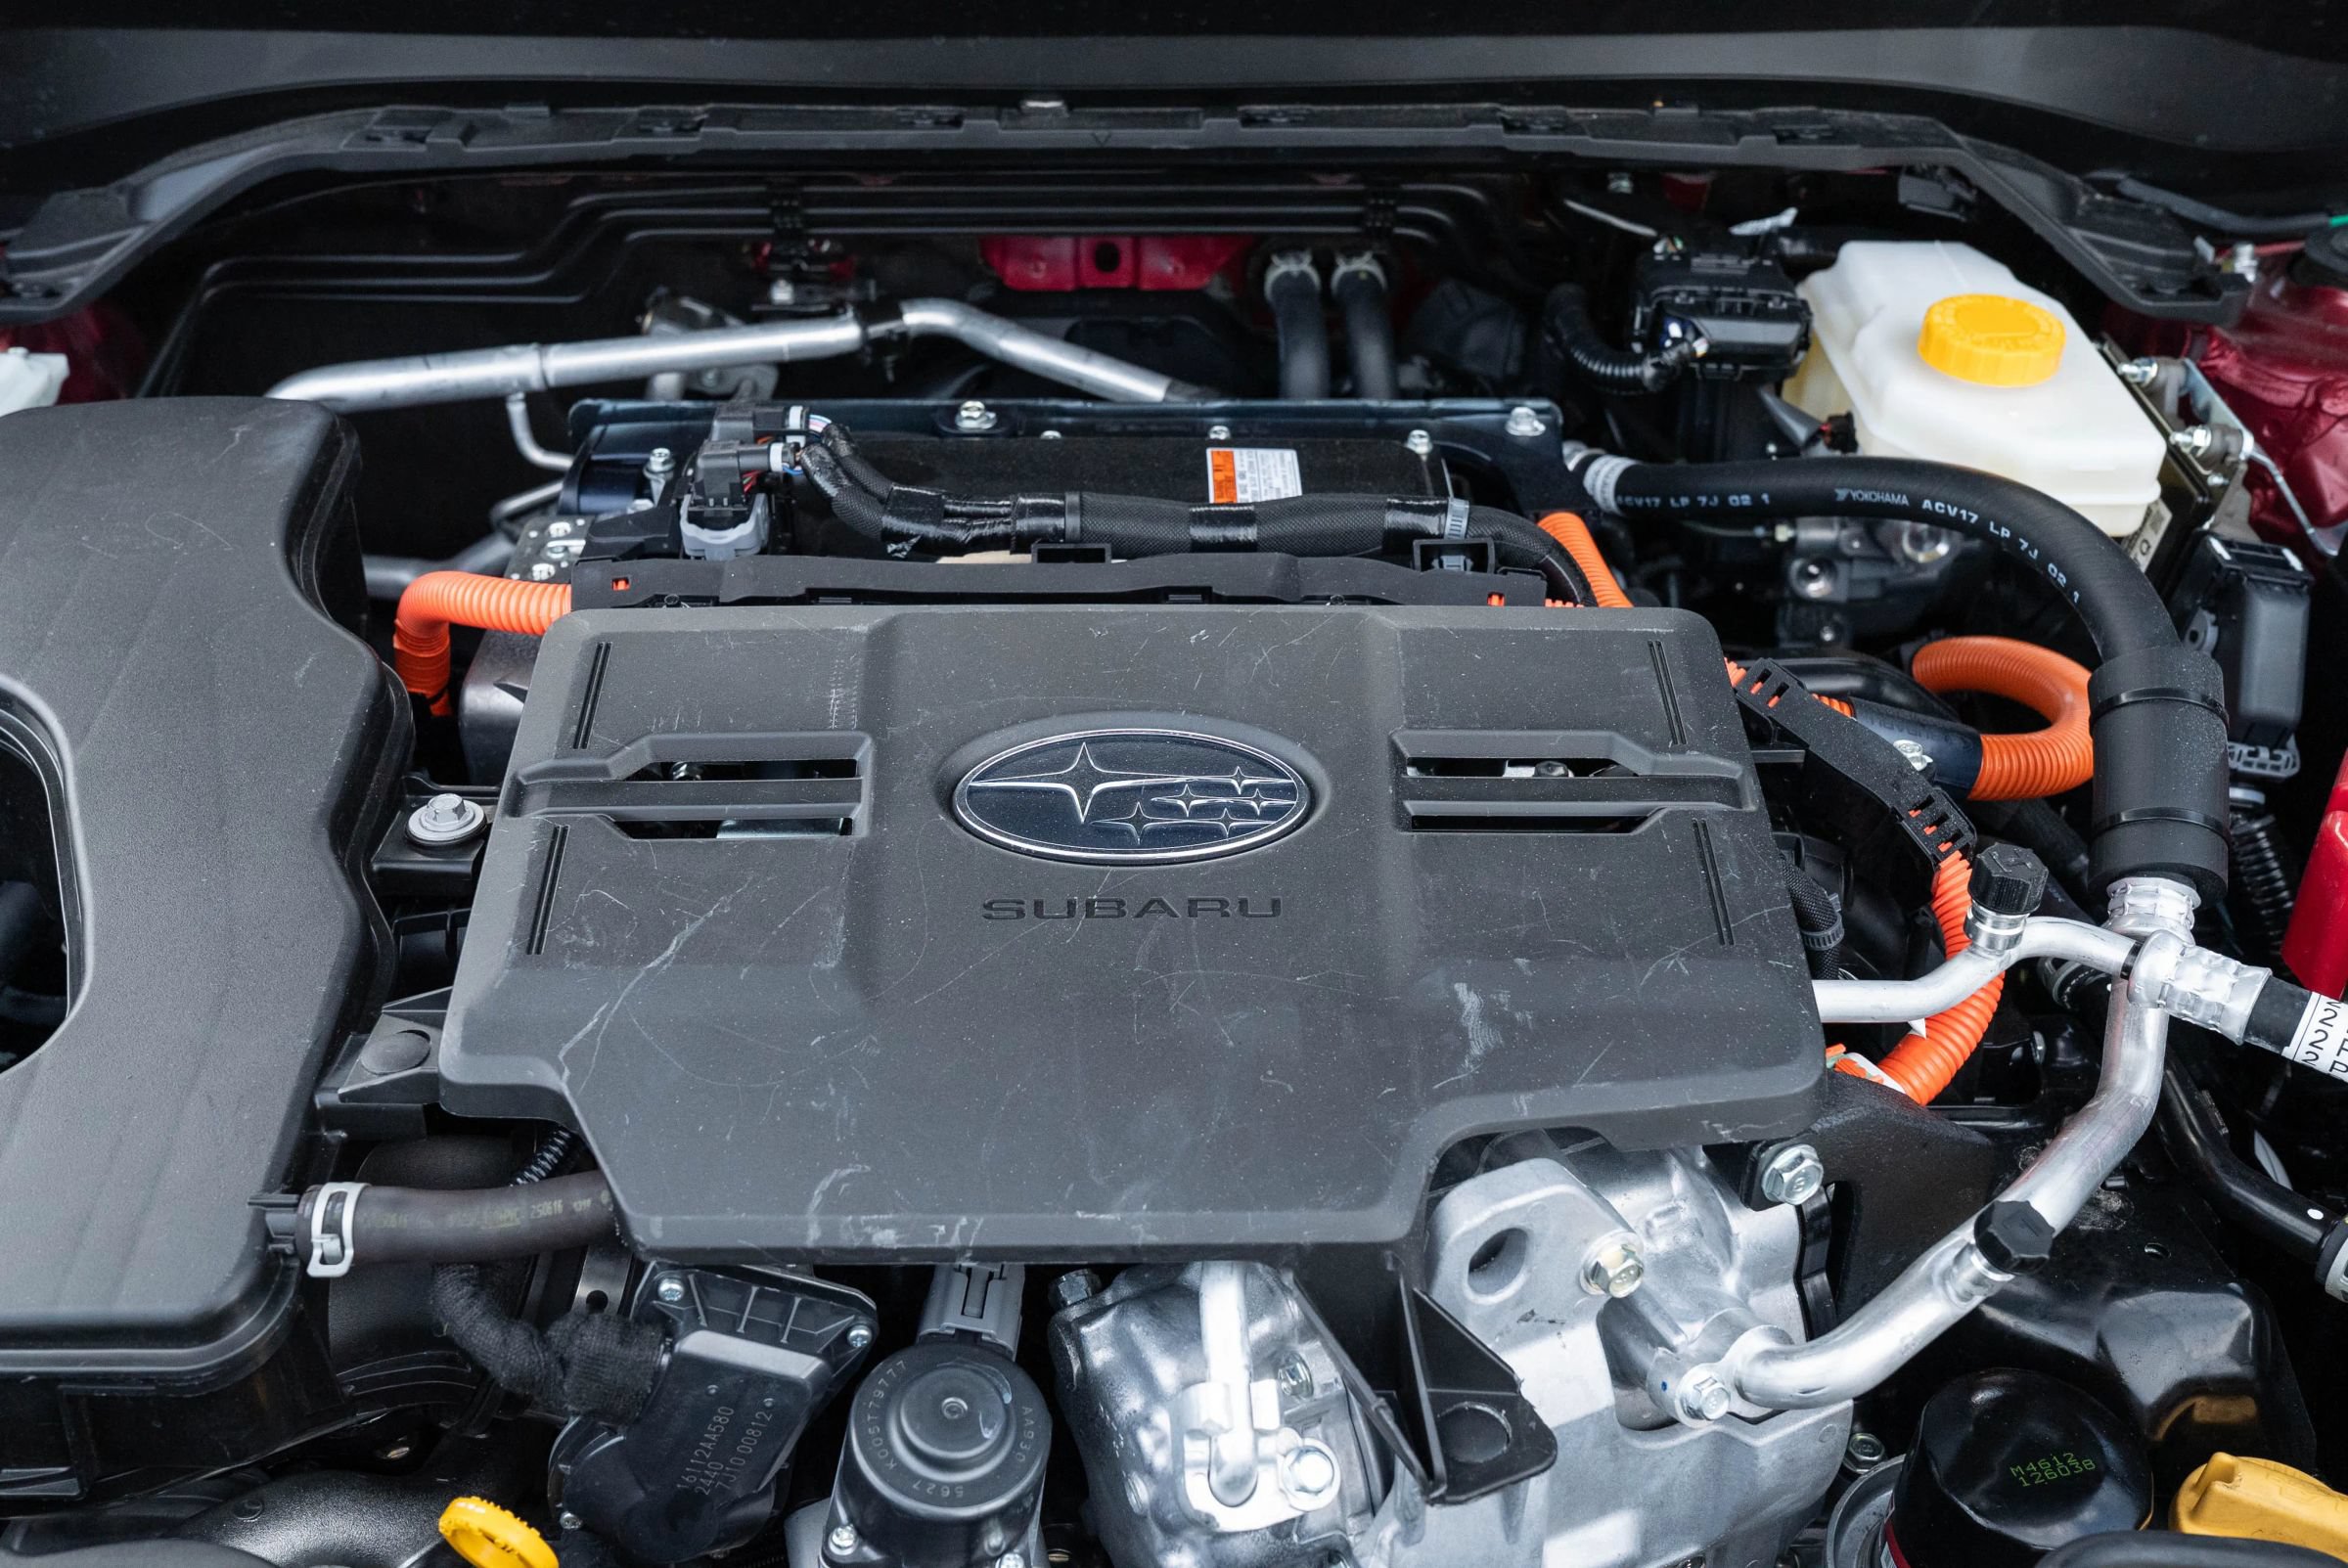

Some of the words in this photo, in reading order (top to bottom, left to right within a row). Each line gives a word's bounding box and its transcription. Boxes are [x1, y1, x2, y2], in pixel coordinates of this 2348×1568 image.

[1670, 497, 1691, 508] LP
[1697, 495, 1719, 507] 7J
[1849, 489, 1910, 507] YOKOHAMA
[1921, 500, 1979, 524] ACV17
[1989, 520, 2011, 540] LP
[2018, 538, 2039, 560] 7J
[2072, 591, 2080, 604] 1
[981, 896, 1282, 920] SUBARU
[676, 1406, 735, 1489] 16112AA580
[1016, 1406, 1035, 1462] AA930
[694, 1461, 724, 1496] 2440
[2009, 1453, 2077, 1477] M4612
[2018, 1458, 2096, 1487] 126038
[912, 1478, 964, 1499] 5627
